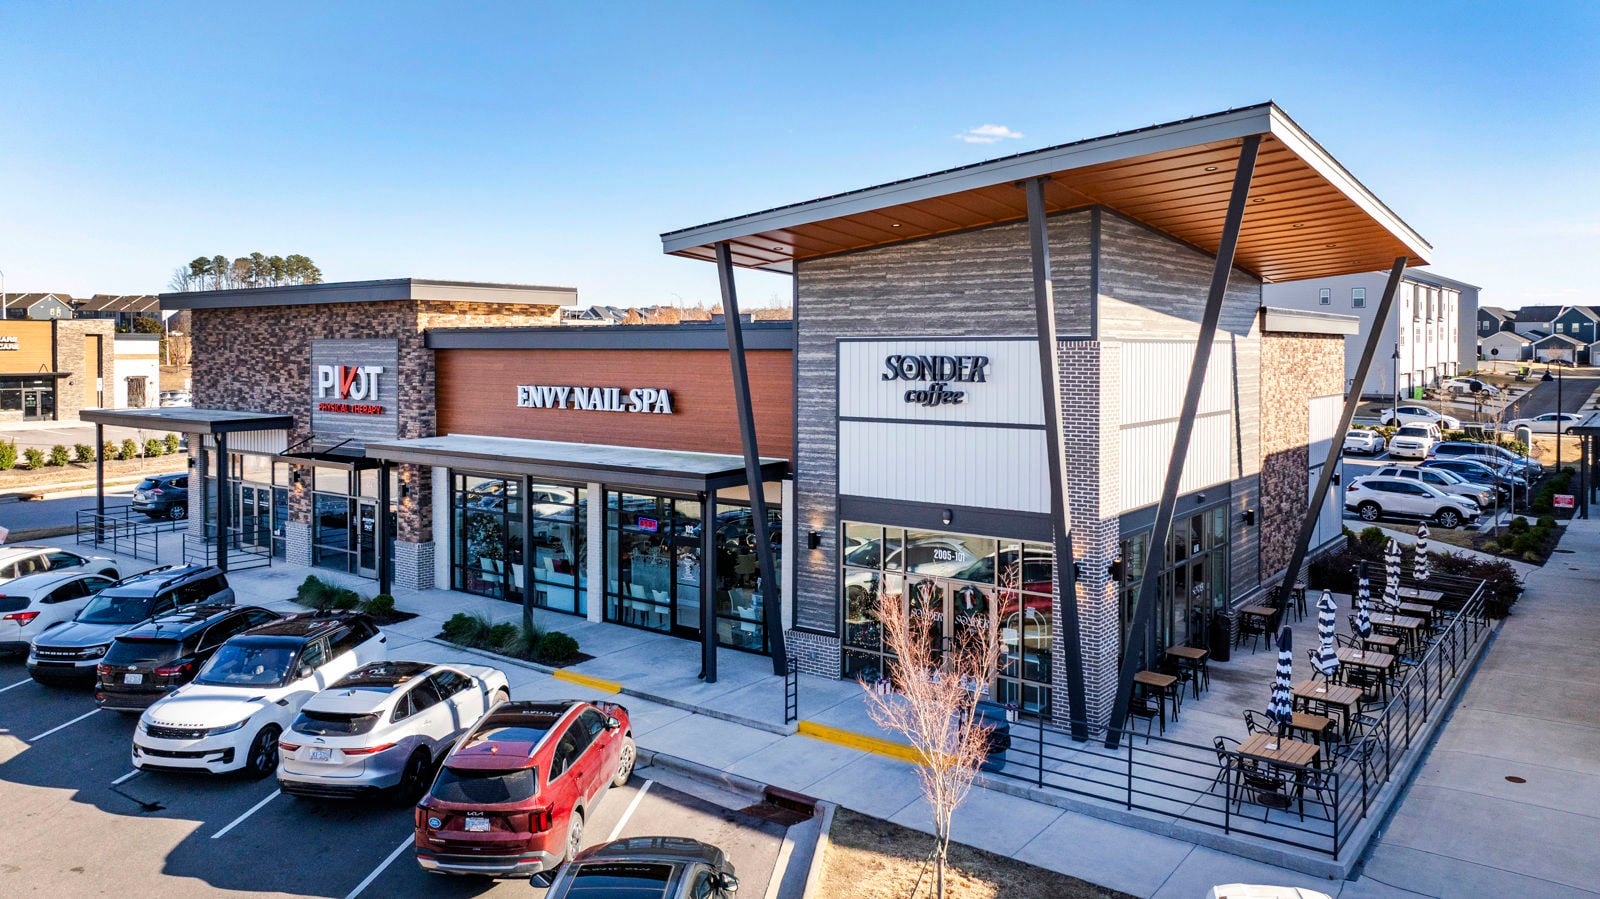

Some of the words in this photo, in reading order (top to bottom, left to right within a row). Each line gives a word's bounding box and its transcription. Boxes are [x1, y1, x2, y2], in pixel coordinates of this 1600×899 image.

[882, 355, 989, 382] SONDER
[318, 365, 383, 400] PIVOT
[904, 383, 965, 407] coffee
[318, 402, 348, 413] PHYSICAL
[351, 404, 383, 416] THERAPY
[517, 385, 571, 409] ENVY
[573, 387, 625, 412] NAIL
[629, 388, 672, 414] SPA
[933, 549, 965, 562] 2005-101
